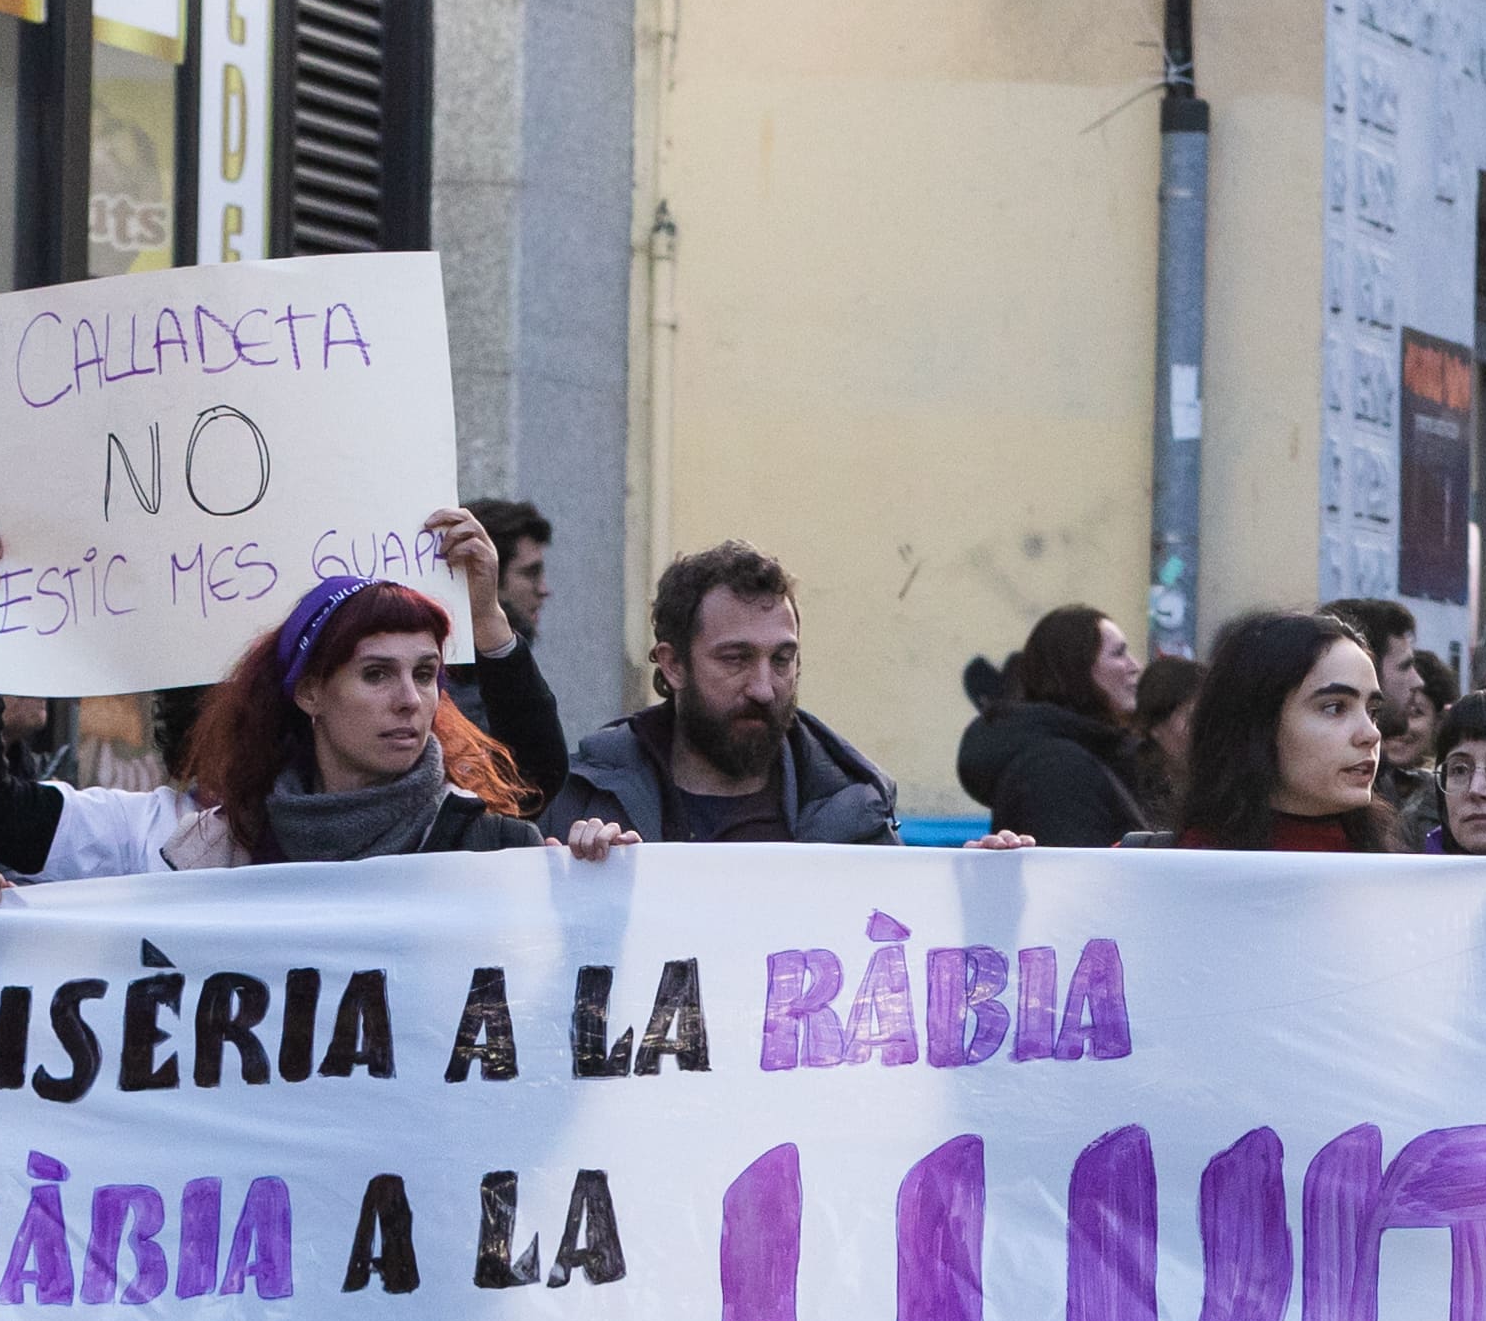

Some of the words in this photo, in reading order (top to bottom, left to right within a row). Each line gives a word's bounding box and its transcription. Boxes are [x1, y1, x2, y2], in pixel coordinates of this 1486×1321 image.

[16, 302, 371, 408] CALLADETA
[104, 405, 270, 521] NO
[171, 542, 277, 618] MES
[312, 529, 454, 580] GUAPA
[445, 965, 519, 1084] A
[570, 958, 710, 1080] LA
[760, 909, 1133, 1071] RÀBIA
[341, 1173, 414, 1295] A
[473, 1168, 626, 1289] LA
